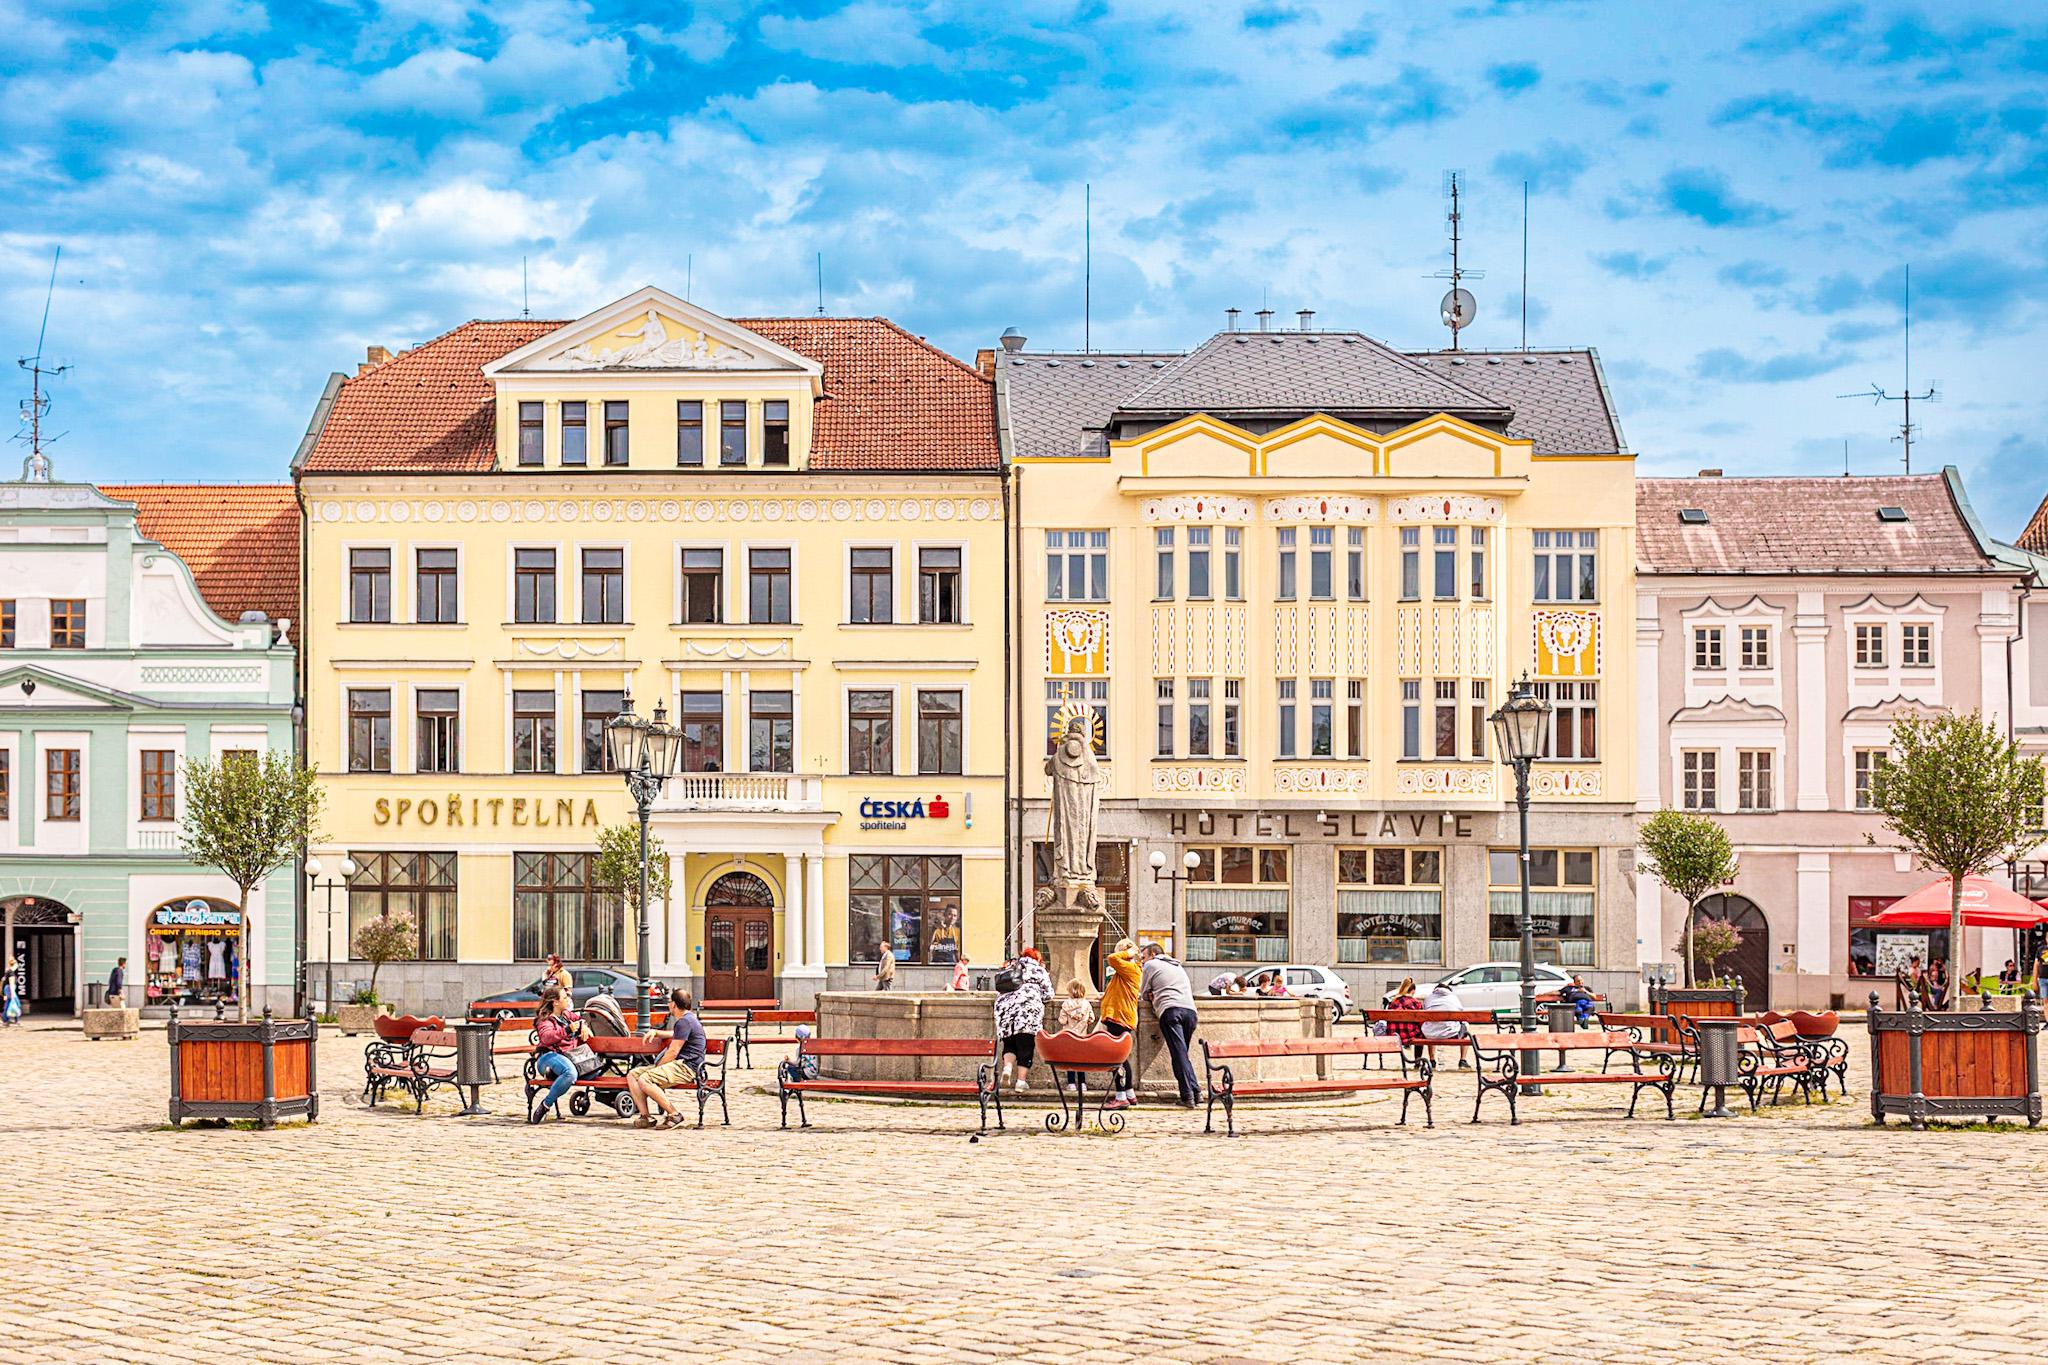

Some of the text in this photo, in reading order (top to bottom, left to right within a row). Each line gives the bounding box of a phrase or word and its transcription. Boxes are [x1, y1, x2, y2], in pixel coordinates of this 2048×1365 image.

[373, 793, 599, 826] SPOŘITELNA
[860, 796, 925, 818] ČESKÁ
[860, 821, 907, 831] spořitelna
[1171, 813, 1300, 836] HOTEL
[1356, 915, 1388, 932] HOTEL
